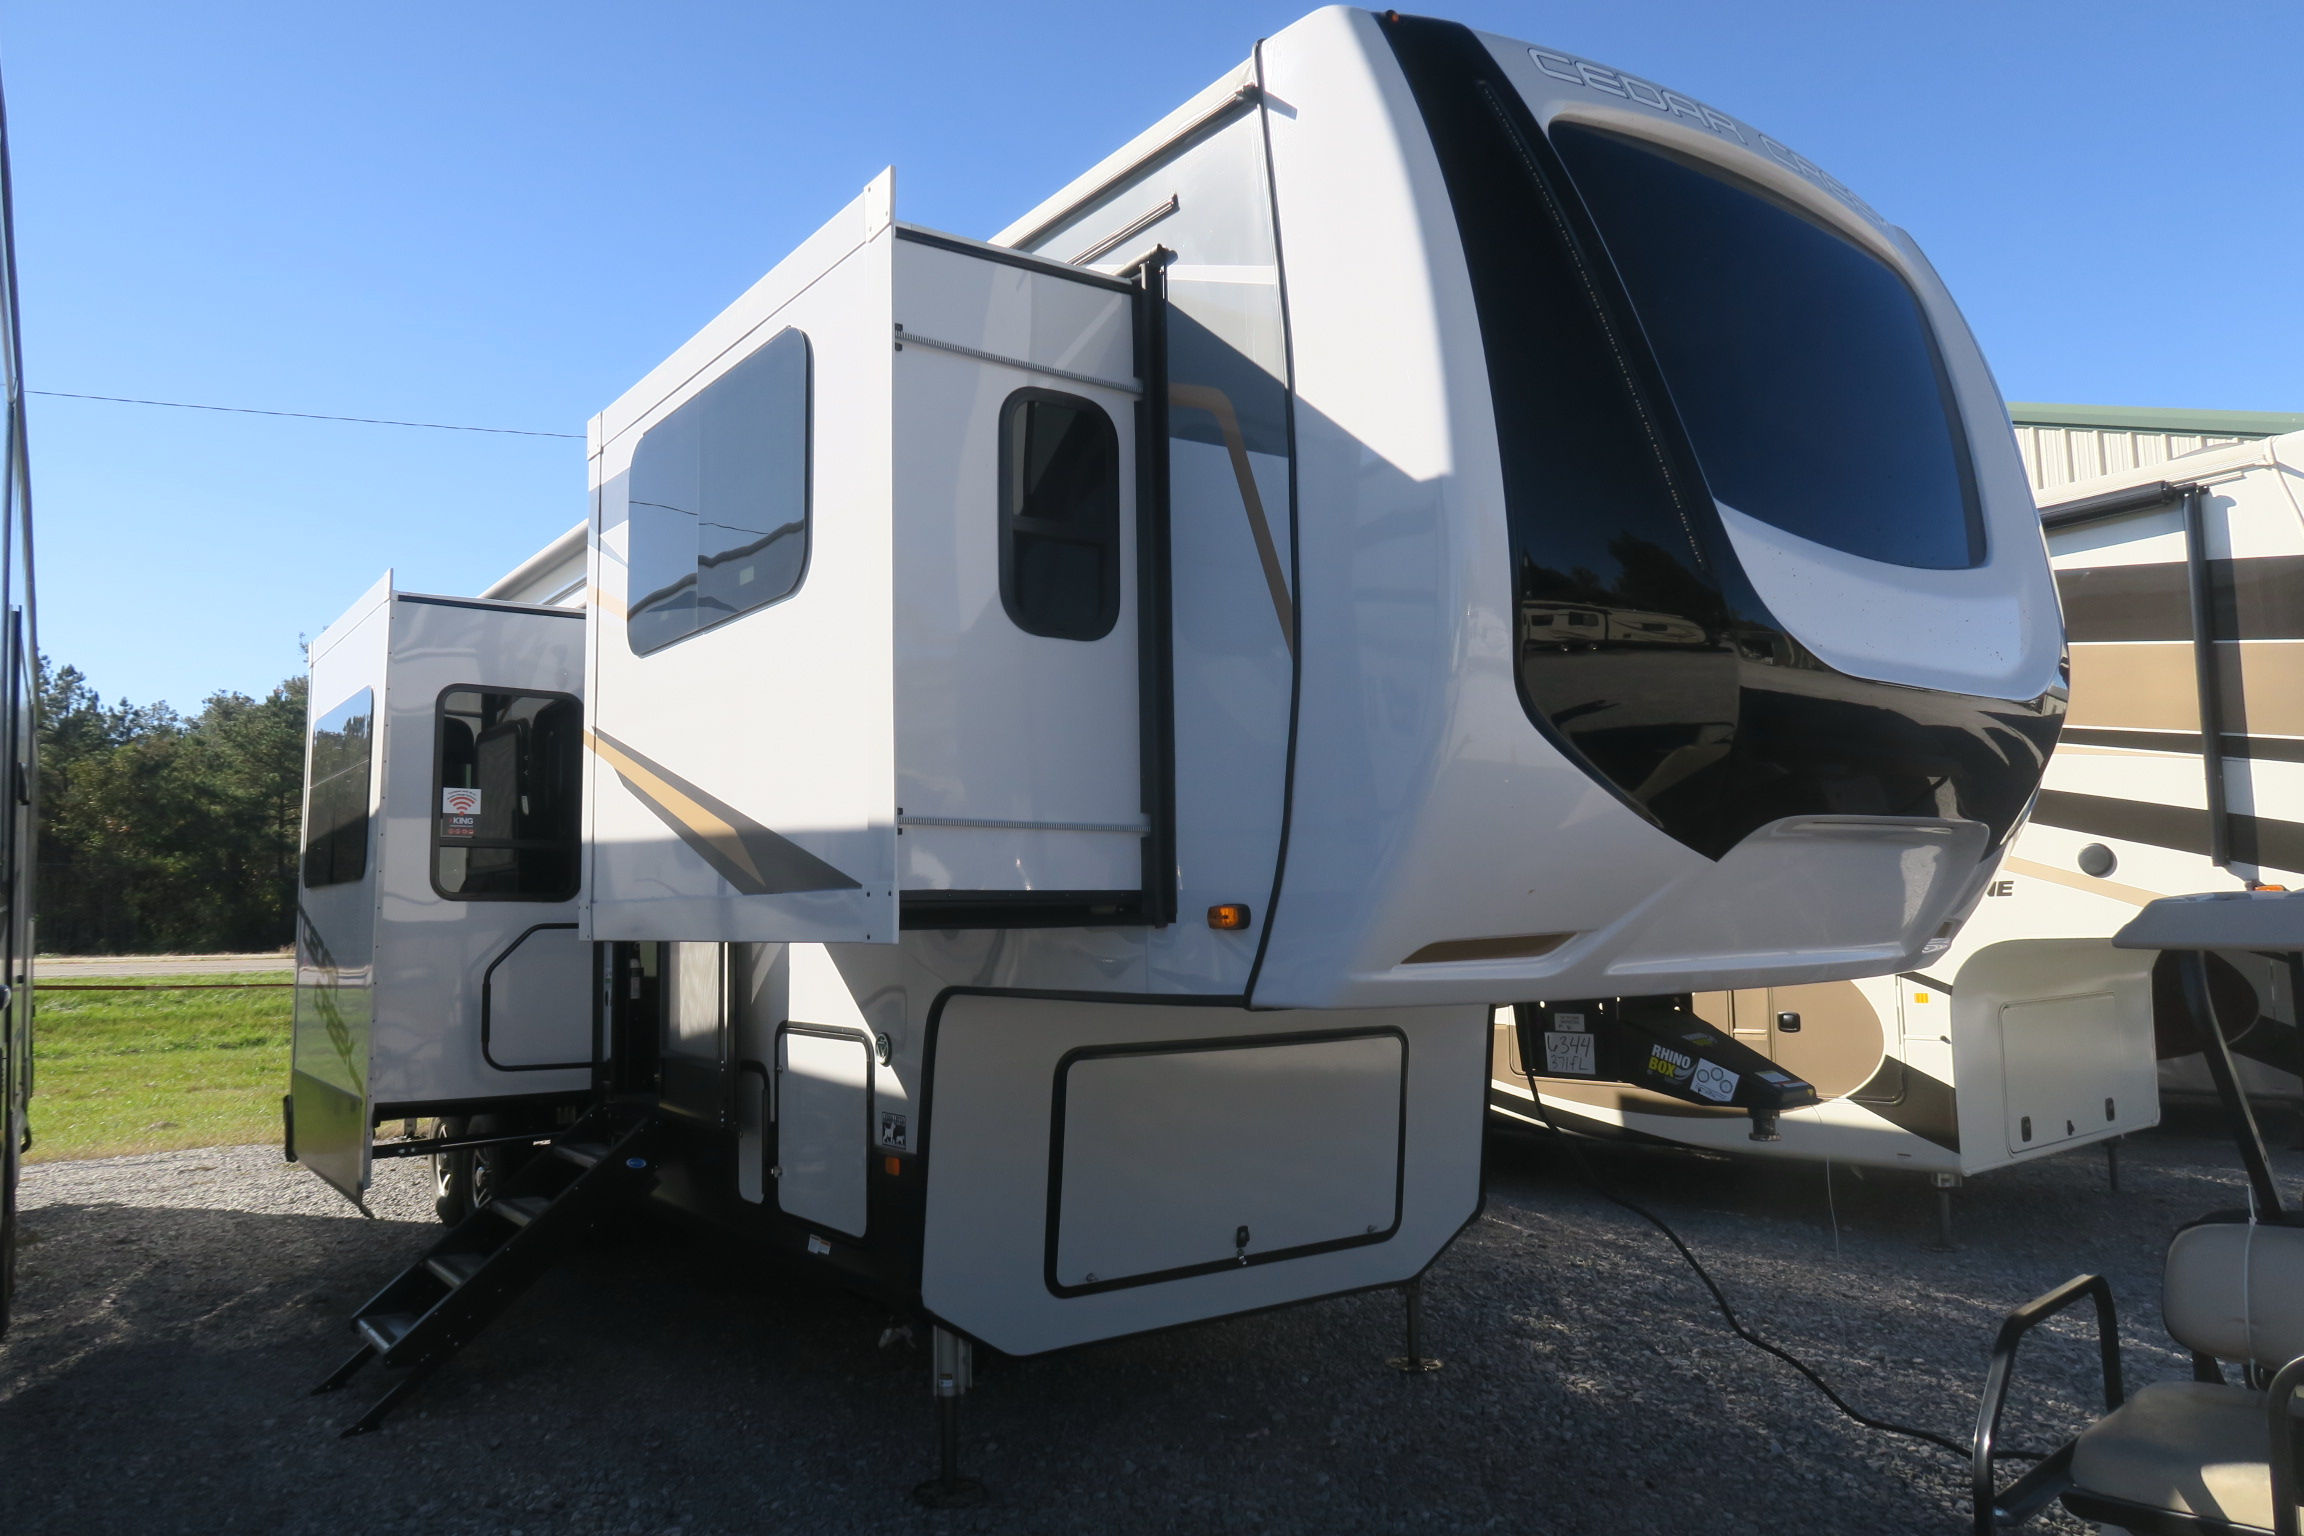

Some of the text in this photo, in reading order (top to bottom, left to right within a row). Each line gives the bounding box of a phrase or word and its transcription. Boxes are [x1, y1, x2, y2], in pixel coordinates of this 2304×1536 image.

[1527, 47, 1748, 146] CEDAR
[453, 817, 474, 825] KING
[1547, 1034, 1591, 1058] 6344
[1651, 1044, 1691, 1069] RHINO
[1648, 1056, 1677, 1078] BOX
